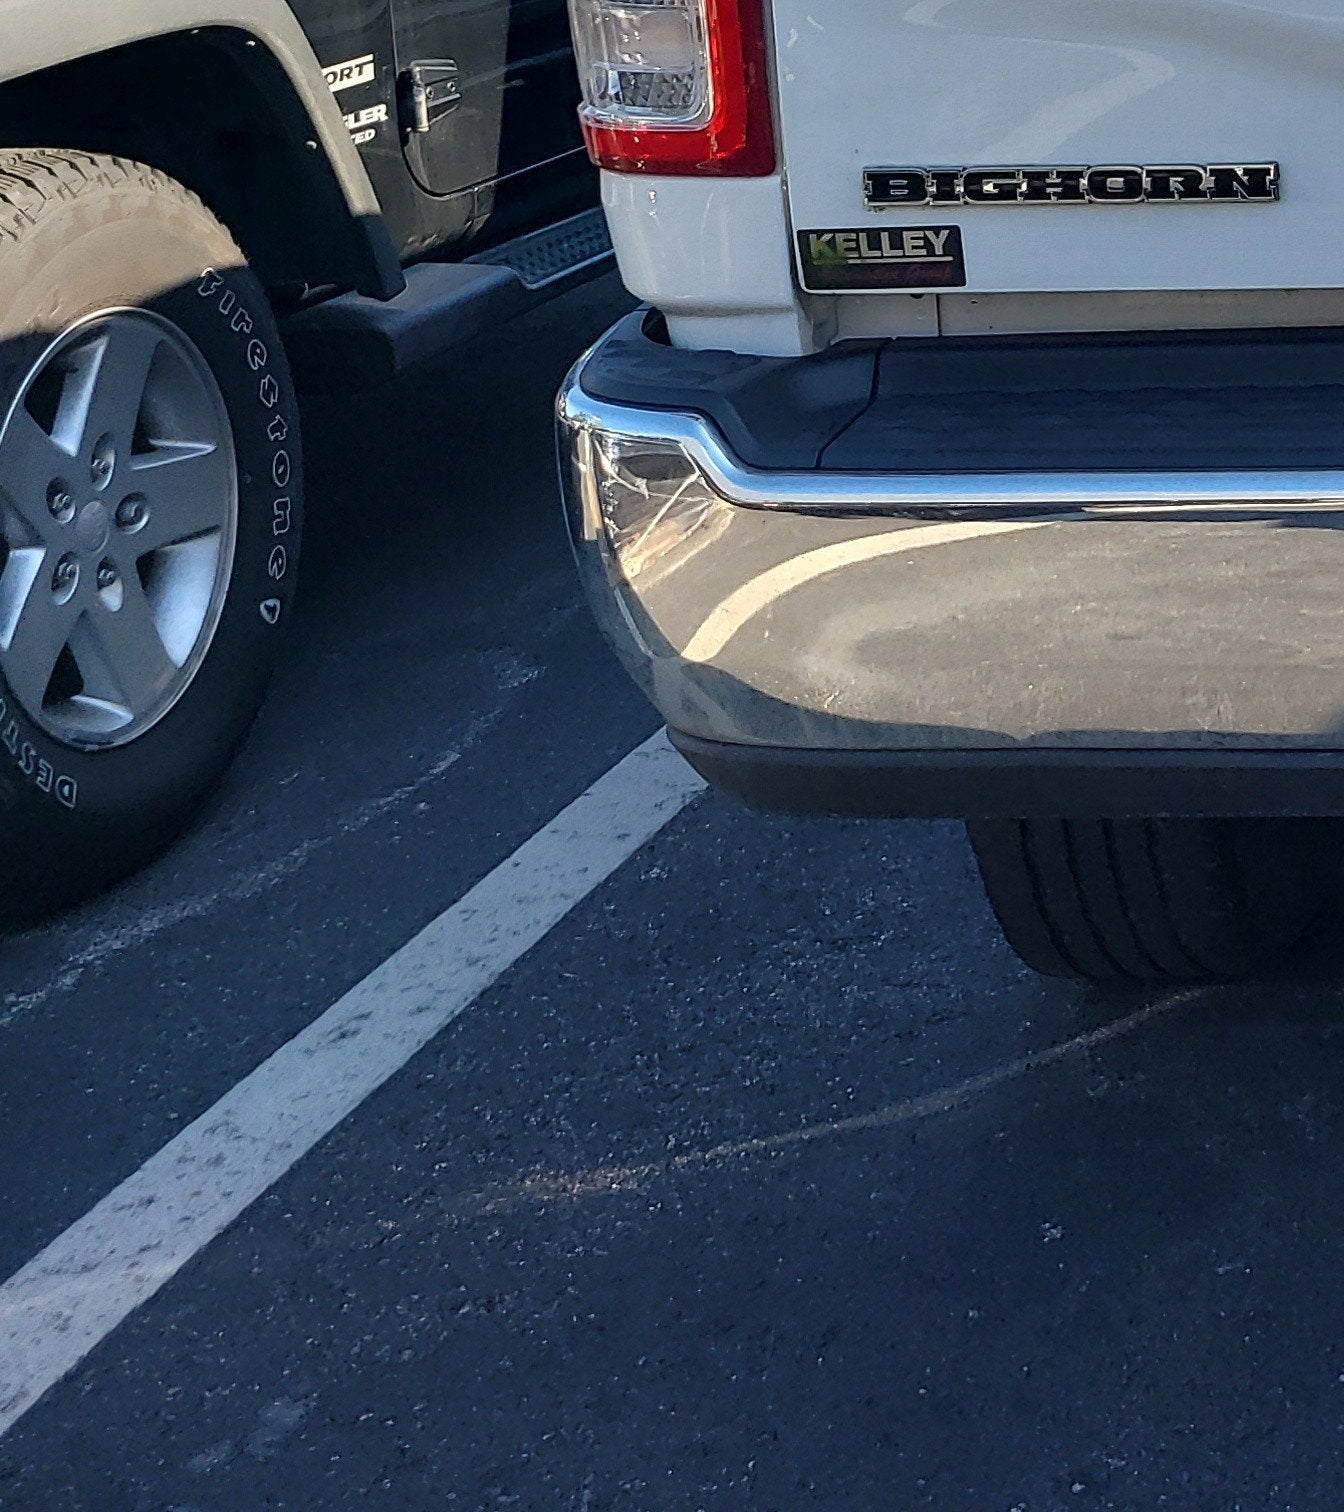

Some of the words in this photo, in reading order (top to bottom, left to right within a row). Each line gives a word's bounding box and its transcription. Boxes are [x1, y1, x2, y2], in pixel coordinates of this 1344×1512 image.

[324, 60, 374, 85] ORT
[862, 162, 1280, 205] BIGHORN
[809, 229, 950, 259] KELLEY
